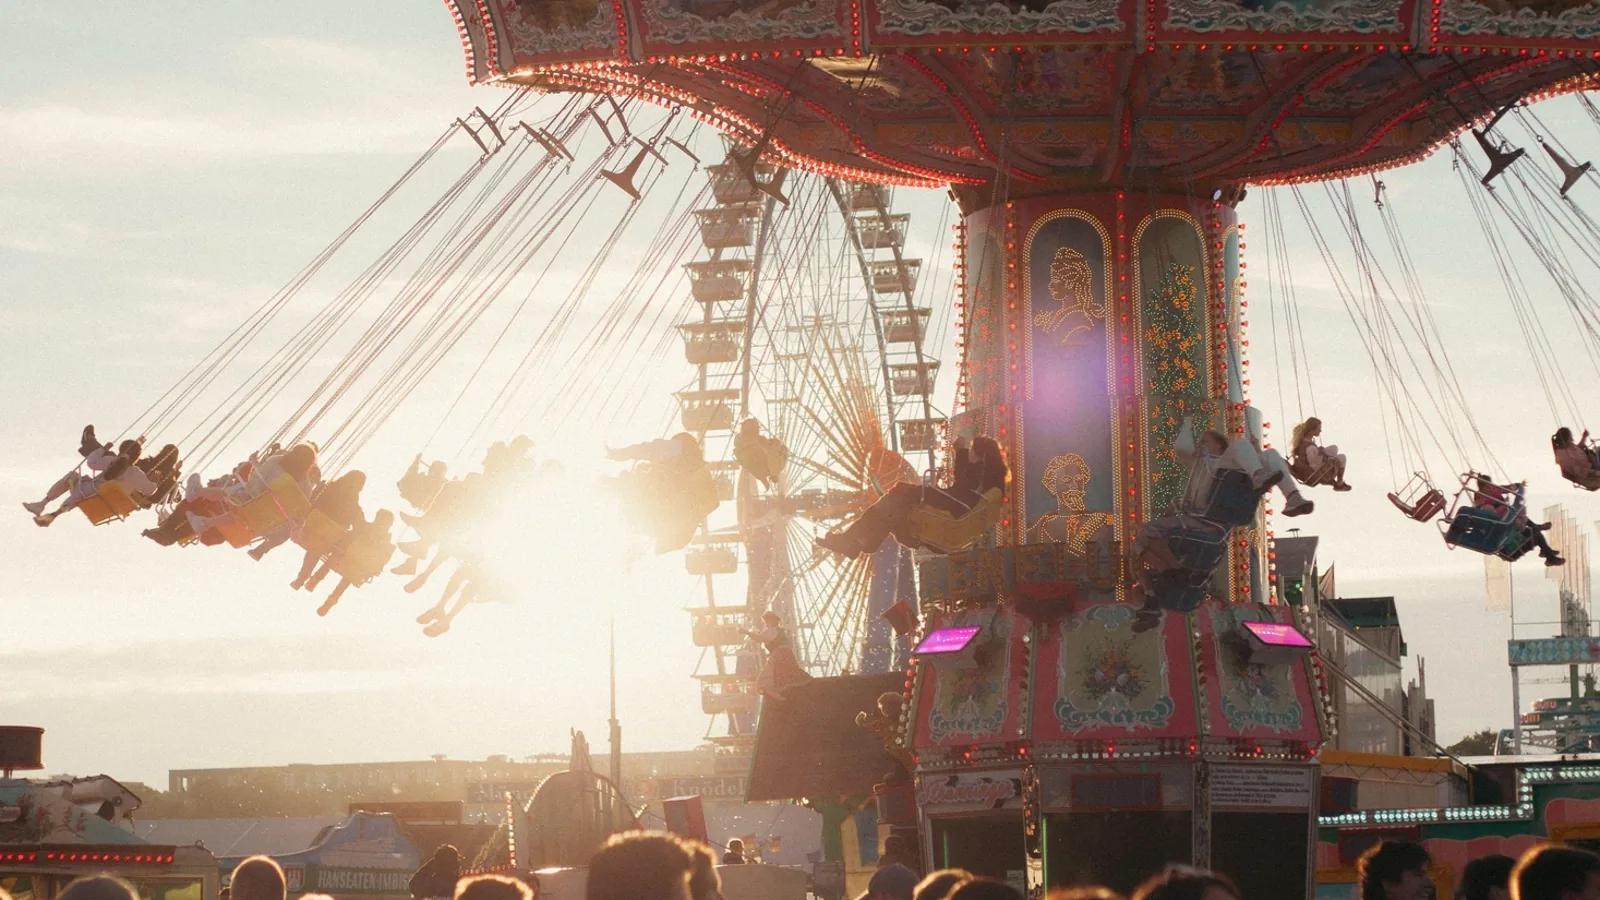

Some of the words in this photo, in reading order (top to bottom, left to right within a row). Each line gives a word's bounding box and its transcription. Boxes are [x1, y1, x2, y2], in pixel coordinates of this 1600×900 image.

[673, 778, 746, 796] Knödel
[318, 869, 376, 889] HANSEATEN
[378, 872, 409, 890] IMBIS
